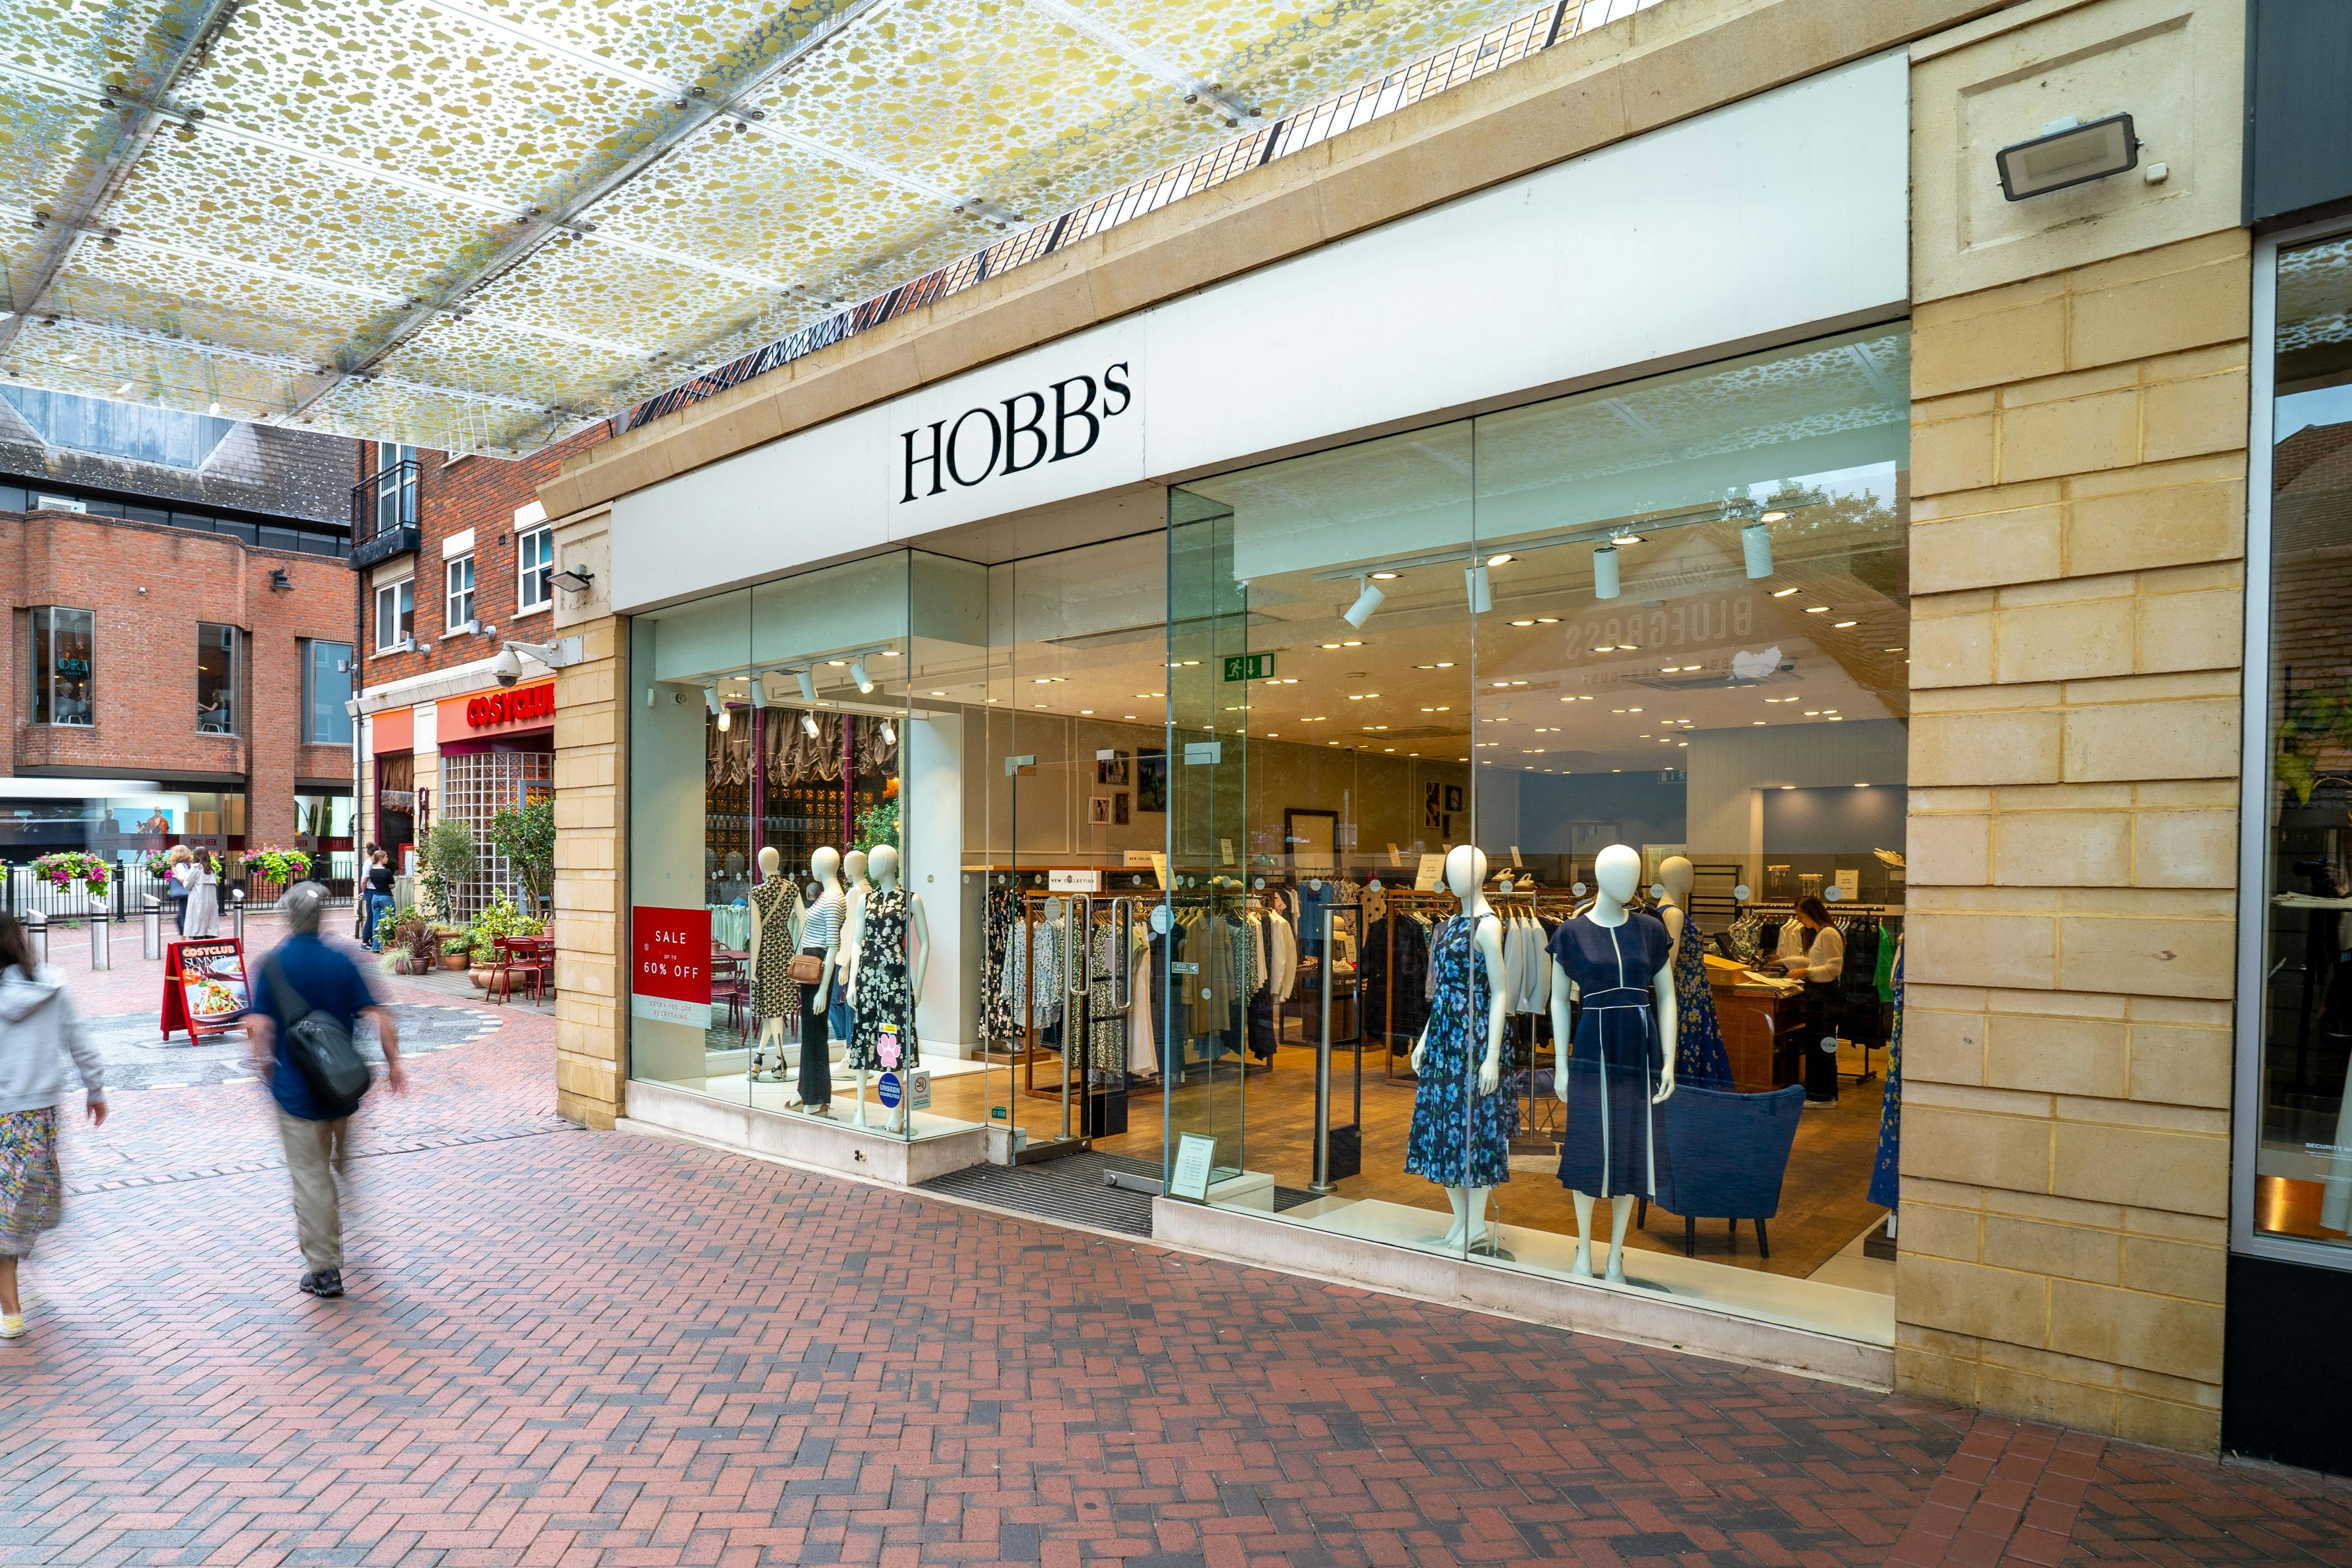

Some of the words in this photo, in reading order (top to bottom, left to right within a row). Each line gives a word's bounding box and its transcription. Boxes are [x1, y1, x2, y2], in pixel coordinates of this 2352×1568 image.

[899, 361, 1131, 504] HOBBS
[58, 658, 89, 671] ORI
[331, 839, 348, 848] SALE
[655, 930, 687, 944] SALE
[183, 945, 235, 957] COSYCLUB
[184, 956, 227, 967] SUMMER
[644, 962, 666, 975] 60%
[674, 965, 698, 979] OFF
[654, 1010, 687, 1020] EVERYTHING
[880, 1084, 900, 1095] UNSEEN
[2305, 1142, 2342, 1152] SECURITY
